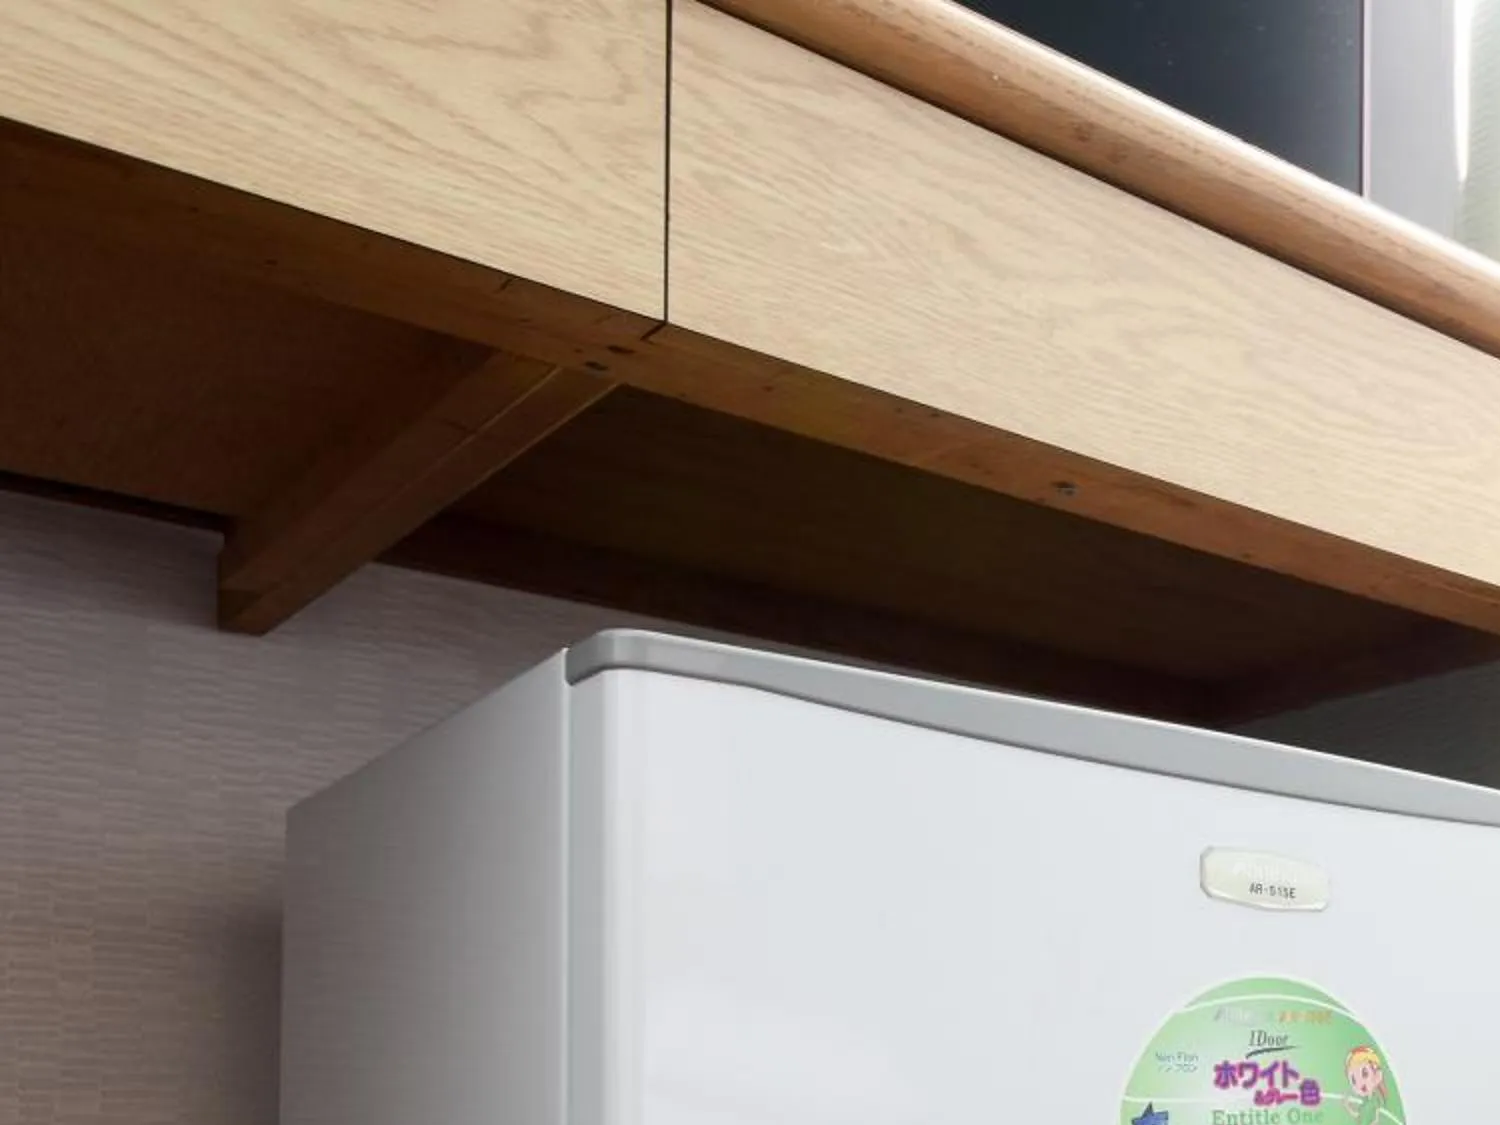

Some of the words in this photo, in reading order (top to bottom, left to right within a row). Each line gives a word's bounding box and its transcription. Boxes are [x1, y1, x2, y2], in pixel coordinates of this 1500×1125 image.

[1213, 1059, 1301, 1089] ホワイト
[1287, 1108, 1324, 1124] One
